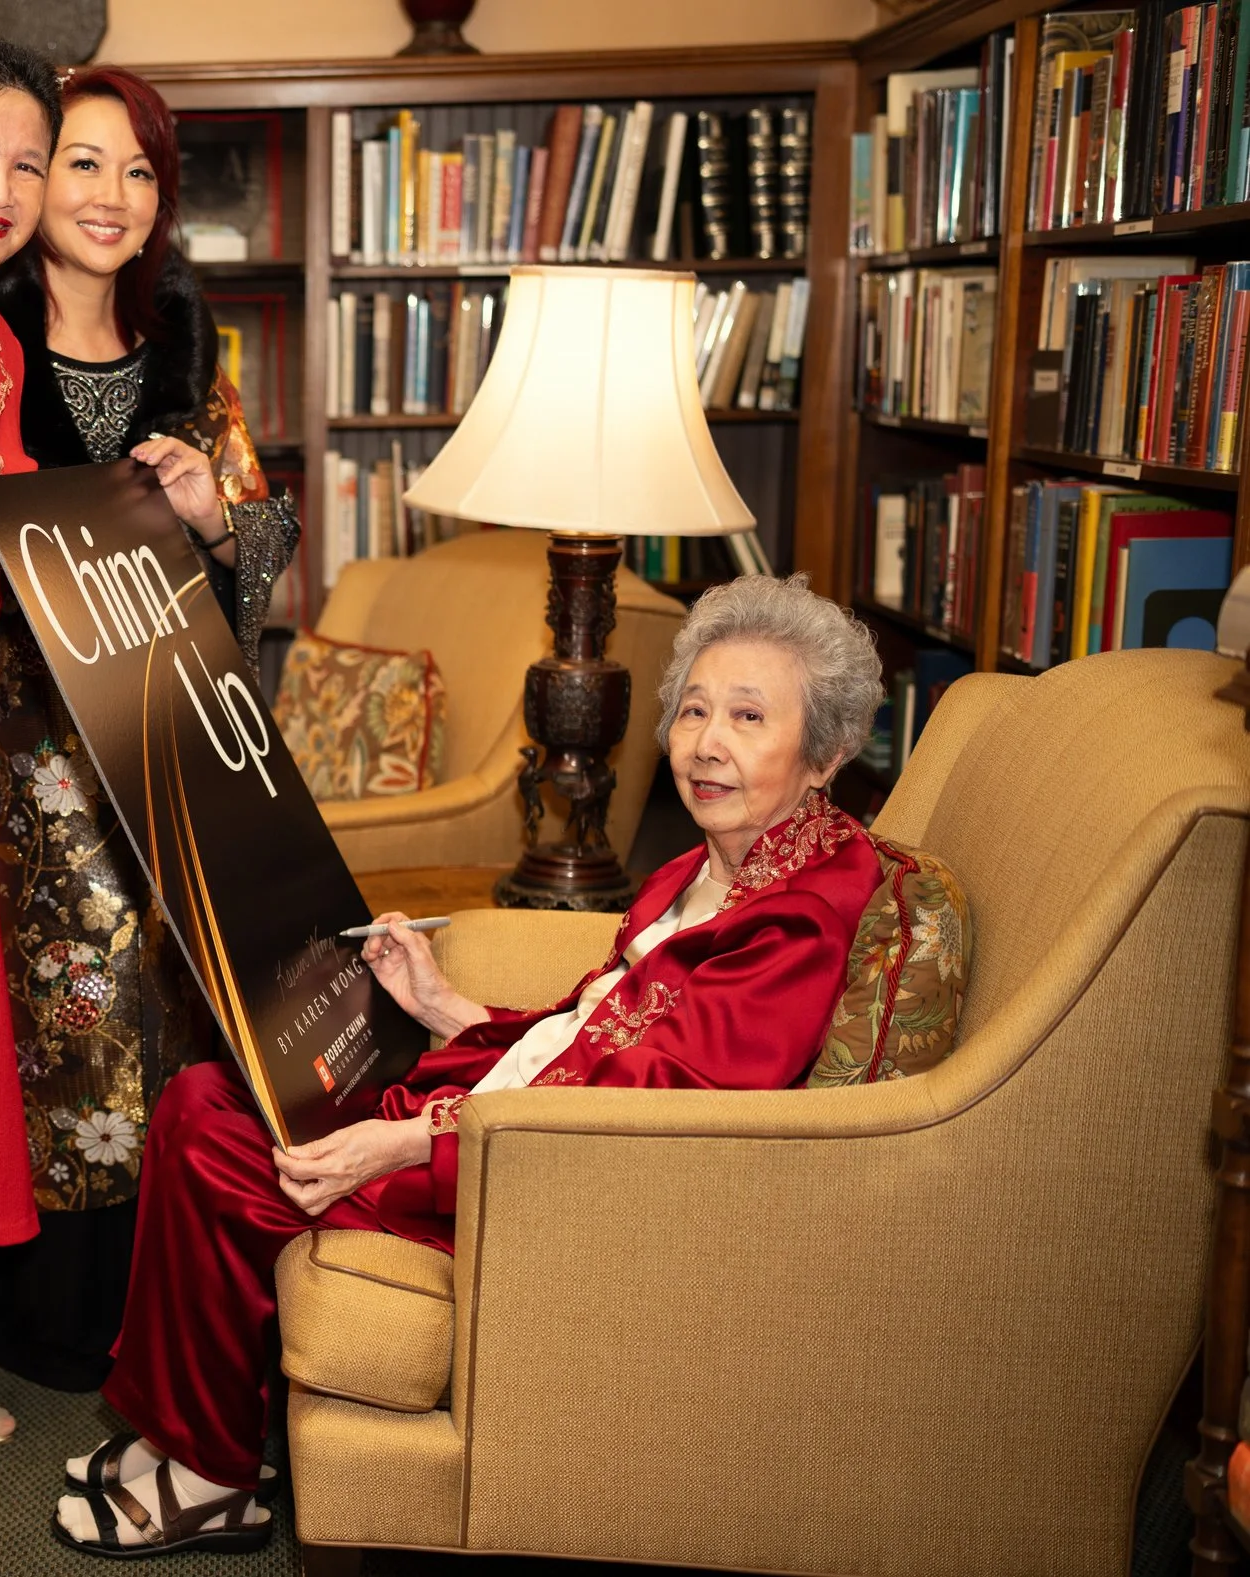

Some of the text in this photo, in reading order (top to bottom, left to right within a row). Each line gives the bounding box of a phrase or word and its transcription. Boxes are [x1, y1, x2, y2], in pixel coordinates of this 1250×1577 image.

[1186, 318, 1196, 344] Bible
[19, 523, 188, 665] Chinn
[174, 641, 277, 798] Up
[276, 957, 363, 1055] BY KAREN WONG
[323, 1011, 367, 1066] ROBERT CHINN
[332, 1028, 373, 1079] FOUNDATION
[341, 1070, 362, 1097] ANNIVERSARY
[359, 1060, 370, 1075] FIRST
